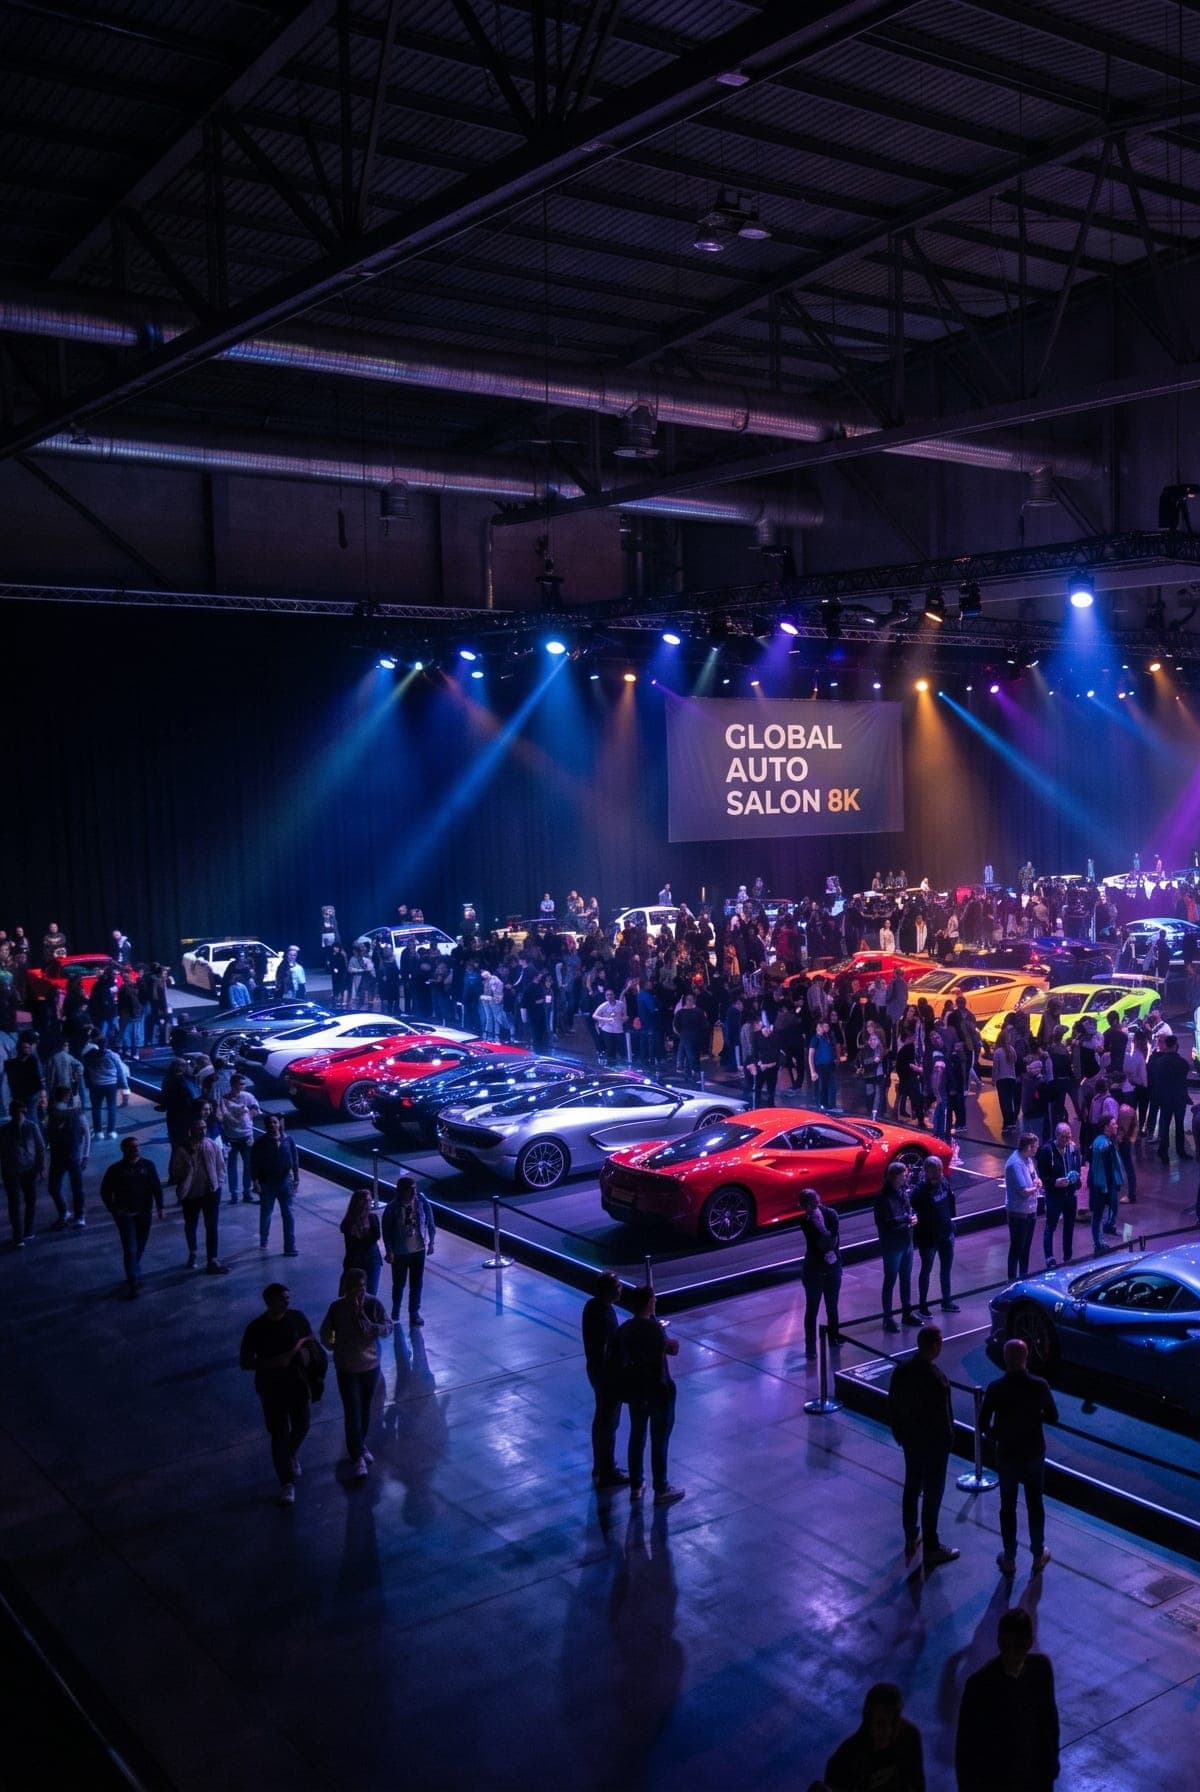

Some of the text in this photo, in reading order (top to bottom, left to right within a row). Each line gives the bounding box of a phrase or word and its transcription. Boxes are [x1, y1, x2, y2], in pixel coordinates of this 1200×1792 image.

[725, 724, 842, 750] GLOBAL
[725, 756, 808, 783] AUTO
[726, 788, 861, 816] SALON 8K
